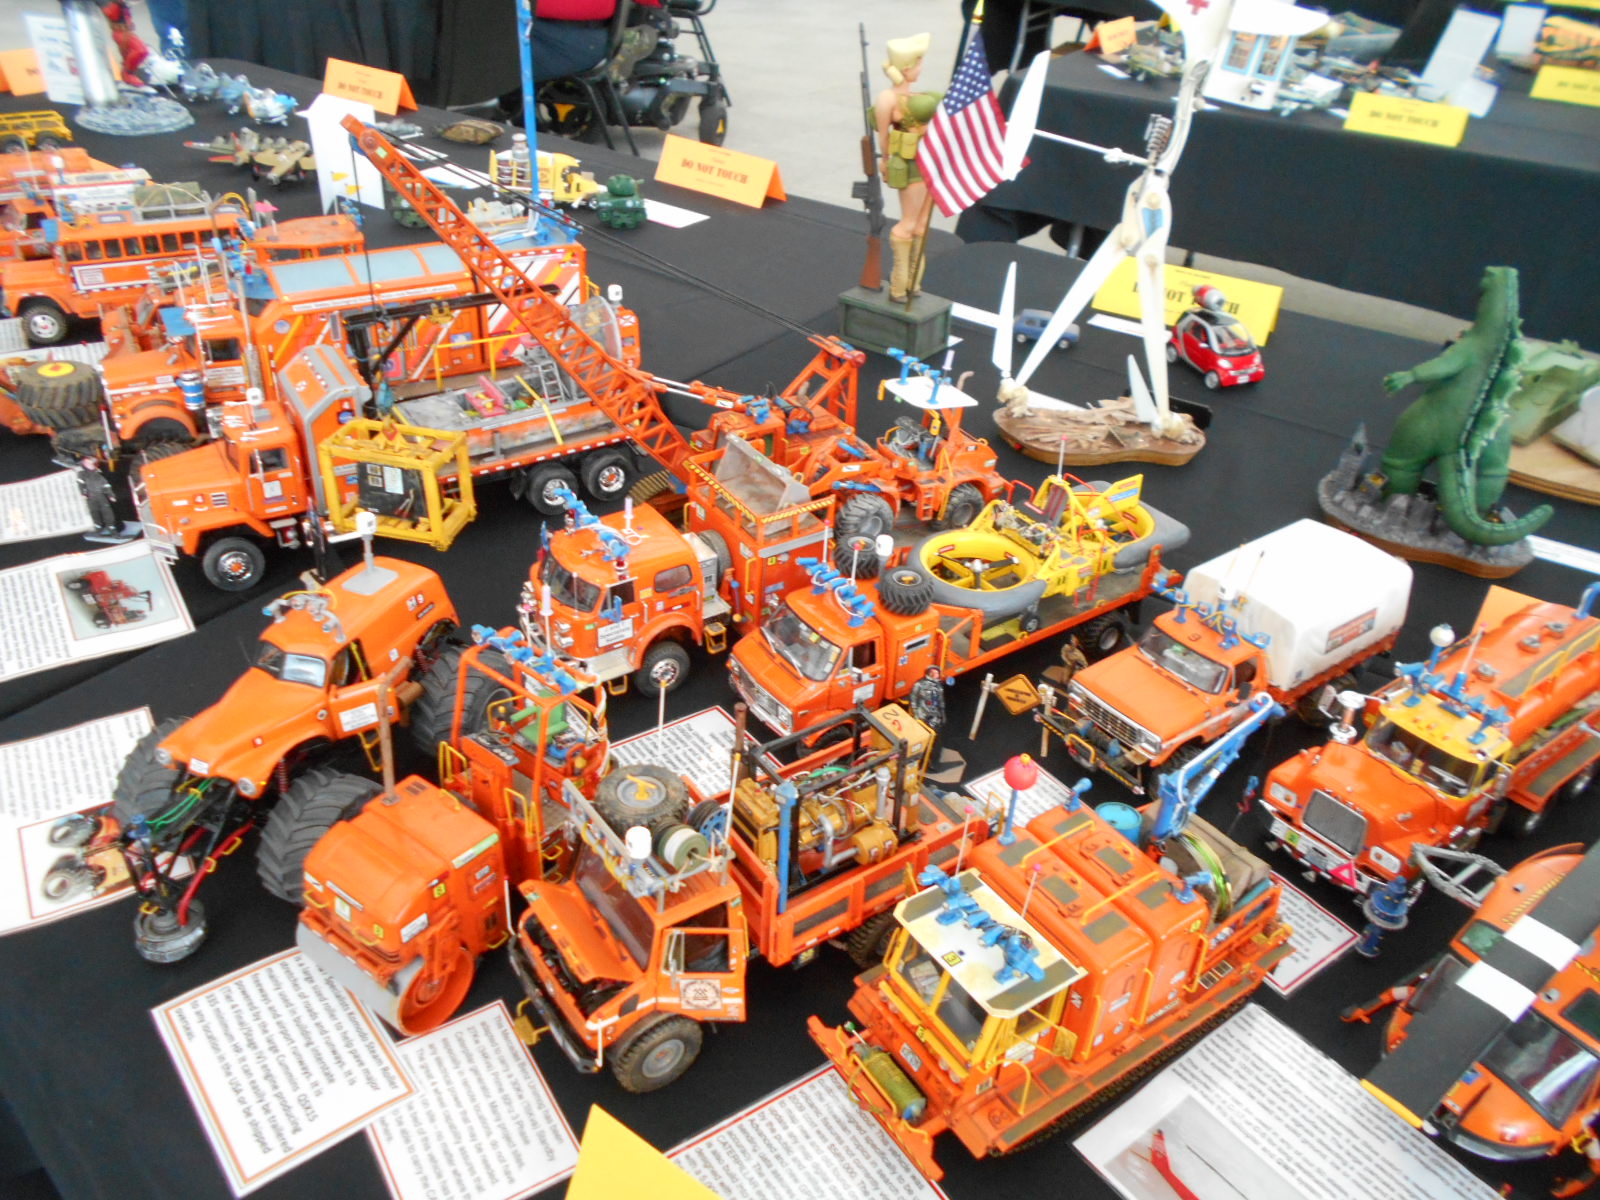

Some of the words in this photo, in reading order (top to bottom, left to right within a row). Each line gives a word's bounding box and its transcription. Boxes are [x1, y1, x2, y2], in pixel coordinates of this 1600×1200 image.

[681, 158, 694, 169] DO
[698, 163, 714, 175] NOT
[717, 168, 749, 184] TOUCH
[204, 992, 219, 1007] 335
[219, 986, 236, 1004] (Tier
[234, 978, 259, 1012] powered
[174, 1006, 197, 1043] overseas.
[193, 1008, 208, 1023] any
[211, 1006, 237, 1043] minimum
[230, 1008, 260, 1052] Final/Stage
[248, 972, 273, 1005] freeways
[265, 1004, 281, 1020] and
[273, 1018, 295, 1047] airport
[287, 1044, 314, 1082] runways.
[255, 1019, 271, 1036] the
[263, 966, 284, 991] mainly
[276, 989, 294, 1009] used
[290, 1015, 316, 1048] building
[307, 1045, 336, 1085] interstate
[278, 959, 303, 992] stretches
[301, 998, 320, 1021] roads
[312, 1019, 328, 1036] and
[321, 1034, 348, 1071] runways.
[298, 965, 318, 985] large
[310, 982, 328, 1002] sized
[322, 1001, 340, 1022] roller
[336, 1029, 356, 1050] help
[347, 1048, 365, 1068] pave
[359, 1066, 381, 1093] major
[200, 1022, 223, 1055] location
[229, 1041, 243, 1056] HP.
[262, 1033, 282, 1055] large
[322, 974, 352, 1012] Specialists
[344, 1010, 371, 1043] Komodo
[362, 1040, 385, 1068] Steam
[376, 1065, 400, 1092] Roller
[219, 1062, 234, 1078] the
[239, 1062, 255, 1079] can
[251, 1050, 266, 1064] IV)
[273, 1053, 301, 1093] Cummins
[226, 1077, 243, 1096] USA
[247, 1078, 267, 1104] easily
[258, 1062, 280, 1092] engine
[272, 1090, 302, 1135] producing
[294, 1092, 318, 1124] QSX15
[246, 1118, 271, 1155] shipped
